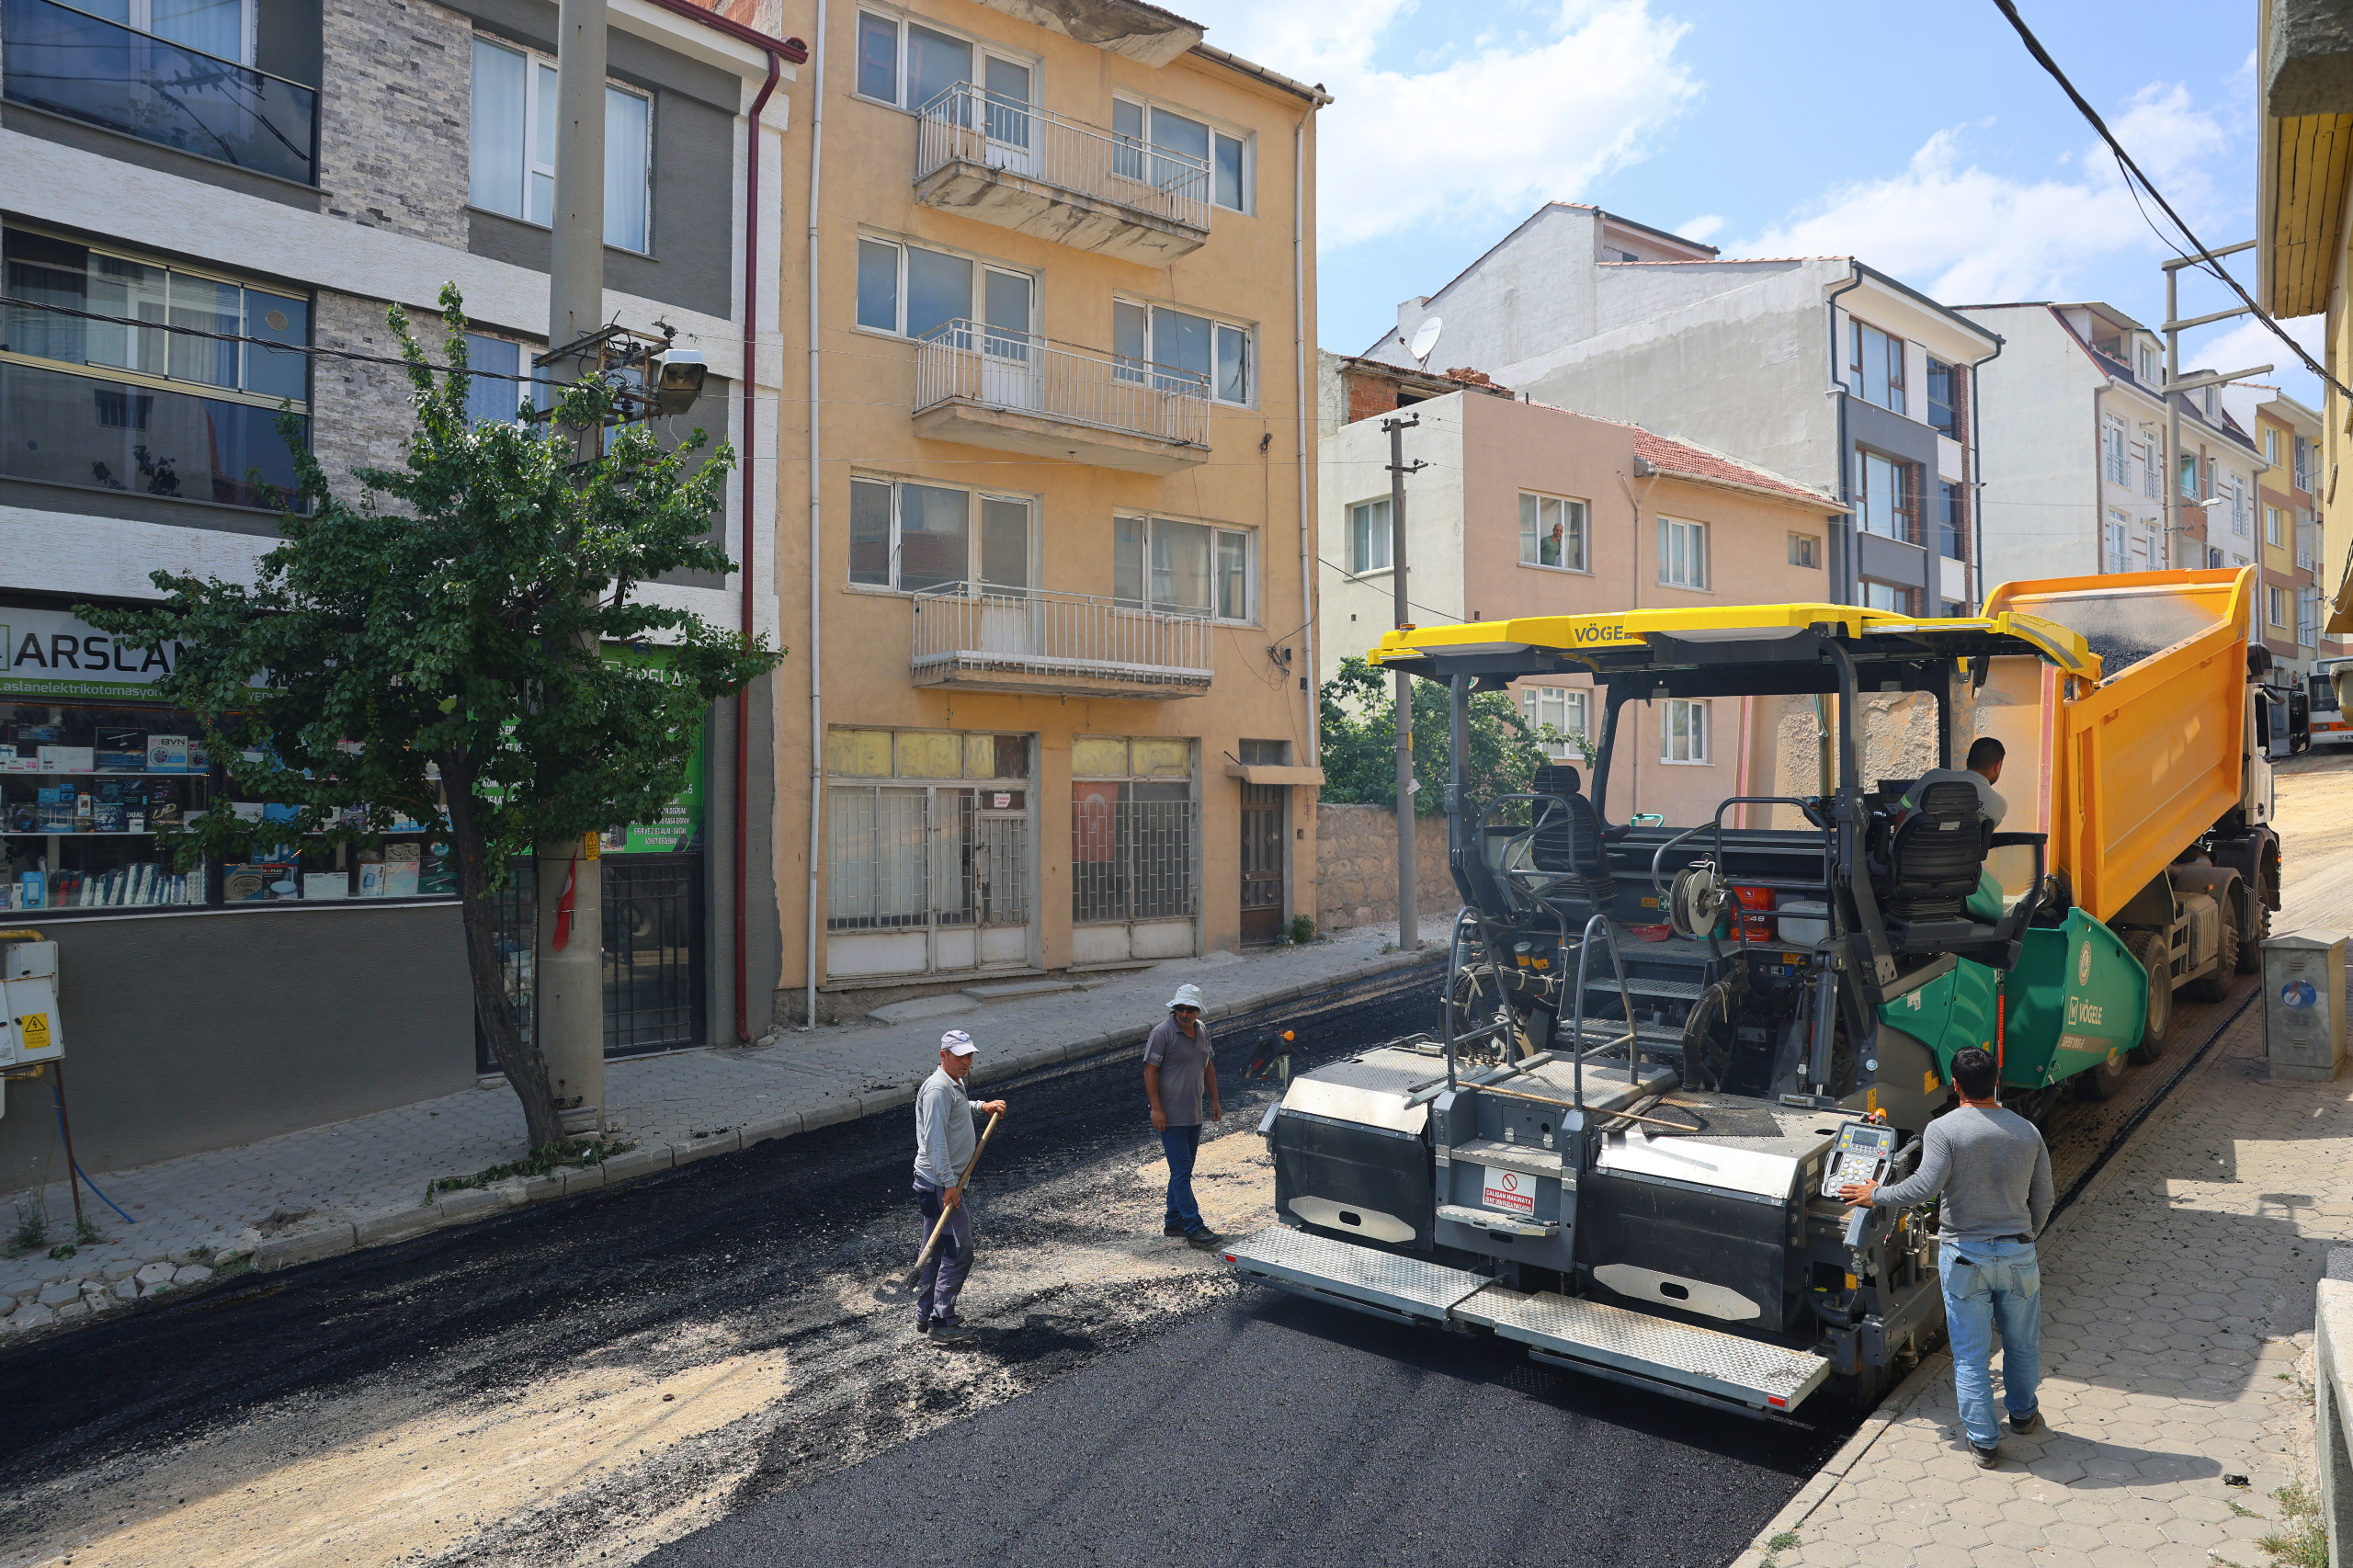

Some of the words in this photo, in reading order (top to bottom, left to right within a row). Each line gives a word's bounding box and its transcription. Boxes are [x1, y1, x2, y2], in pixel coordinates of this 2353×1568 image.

[1574, 622, 1633, 642] VÖGE
[2079, 998, 2103, 1025] VÖGELE
[1485, 1189, 1506, 1199] ÇALIŞAN
